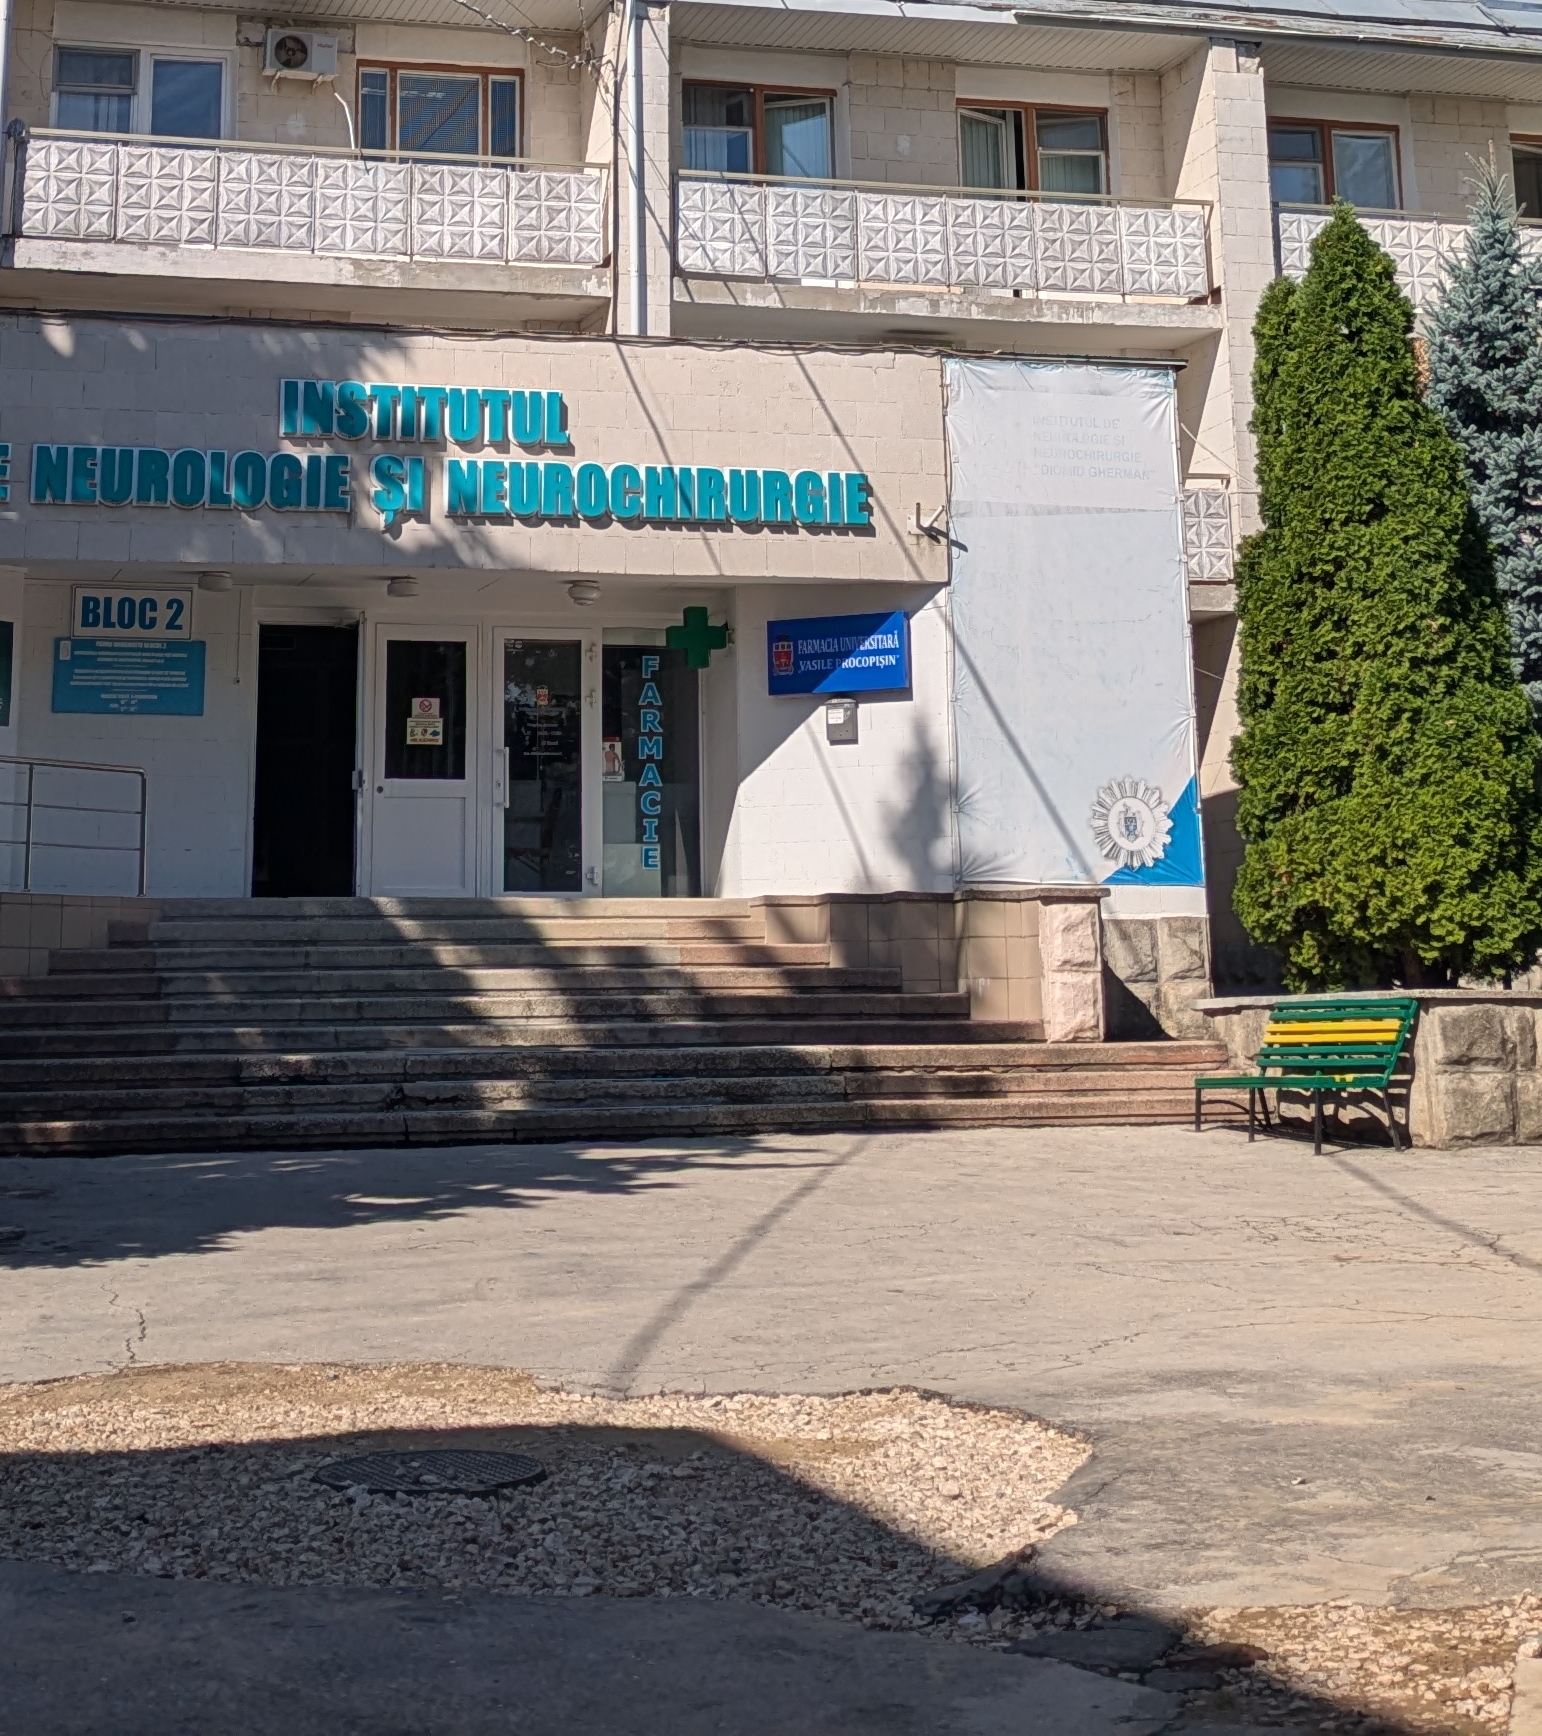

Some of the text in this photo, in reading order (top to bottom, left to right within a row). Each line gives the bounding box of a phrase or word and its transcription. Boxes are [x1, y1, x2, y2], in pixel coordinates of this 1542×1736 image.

[280, 378, 570, 446] INSTITUTUL
[1103, 417, 1120, 429] DE
[1034, 447, 1142, 463] NEUROCHIRURGIE
[30, 442, 351, 514] NEUROLOGIE
[446, 458, 872, 528] NEUROCHIRURGIE
[80, 595, 185, 630] BLOC 2
[797, 630, 899, 654] FARMACIA UNIVERSITARĂ
[638, 655, 663, 870] FARMACIE
